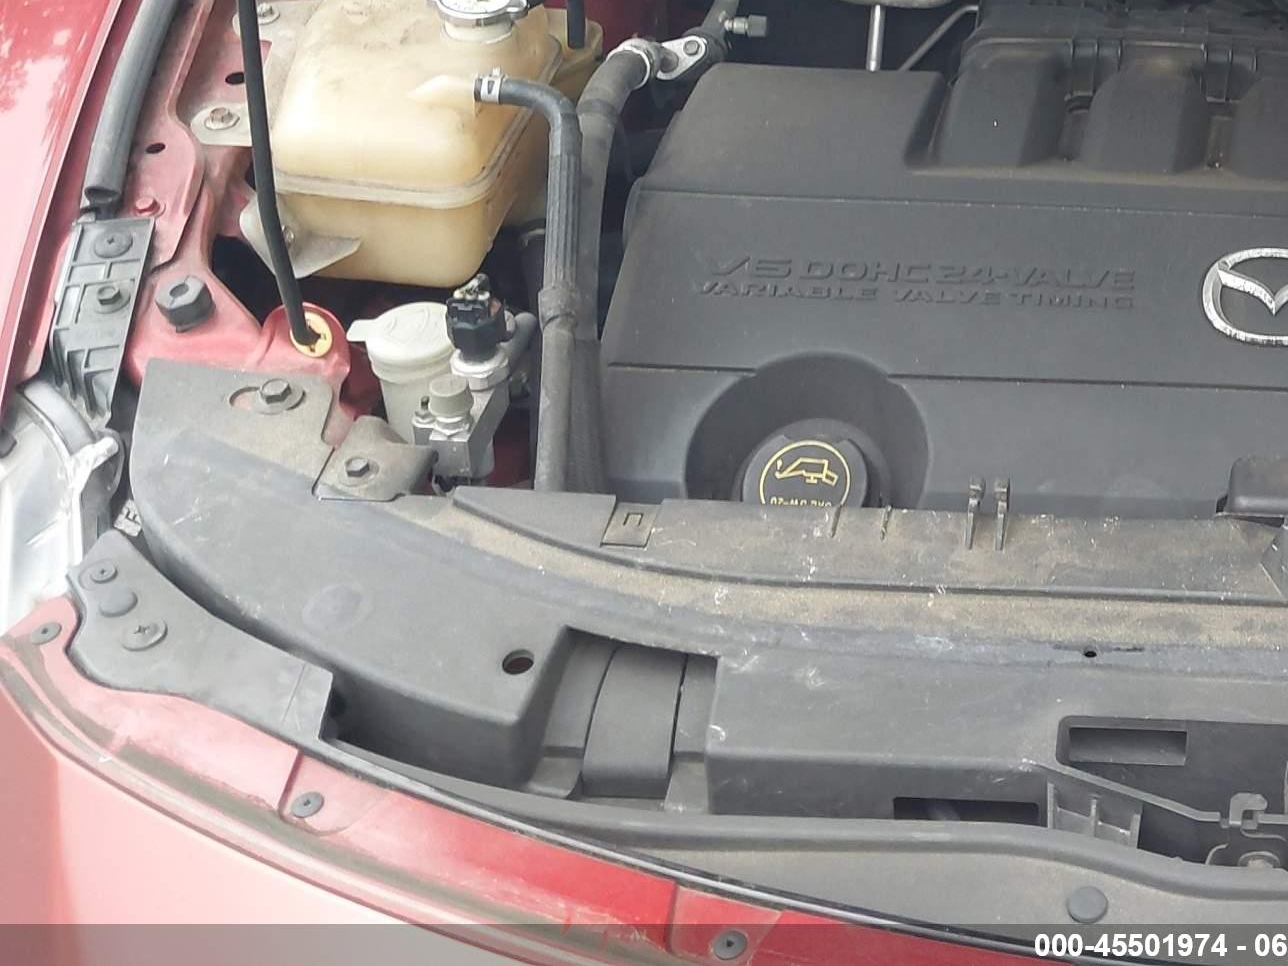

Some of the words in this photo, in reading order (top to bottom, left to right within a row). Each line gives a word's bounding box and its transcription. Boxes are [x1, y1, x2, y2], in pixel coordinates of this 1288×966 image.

[798, 260, 931, 284] DOHC
[935, 265, 1136, 291] 24-VALVE
[698, 281, 879, 301] VARIABLE
[893, 288, 1002, 306] VALVE
[1010, 292, 1134, 310] TIMING
